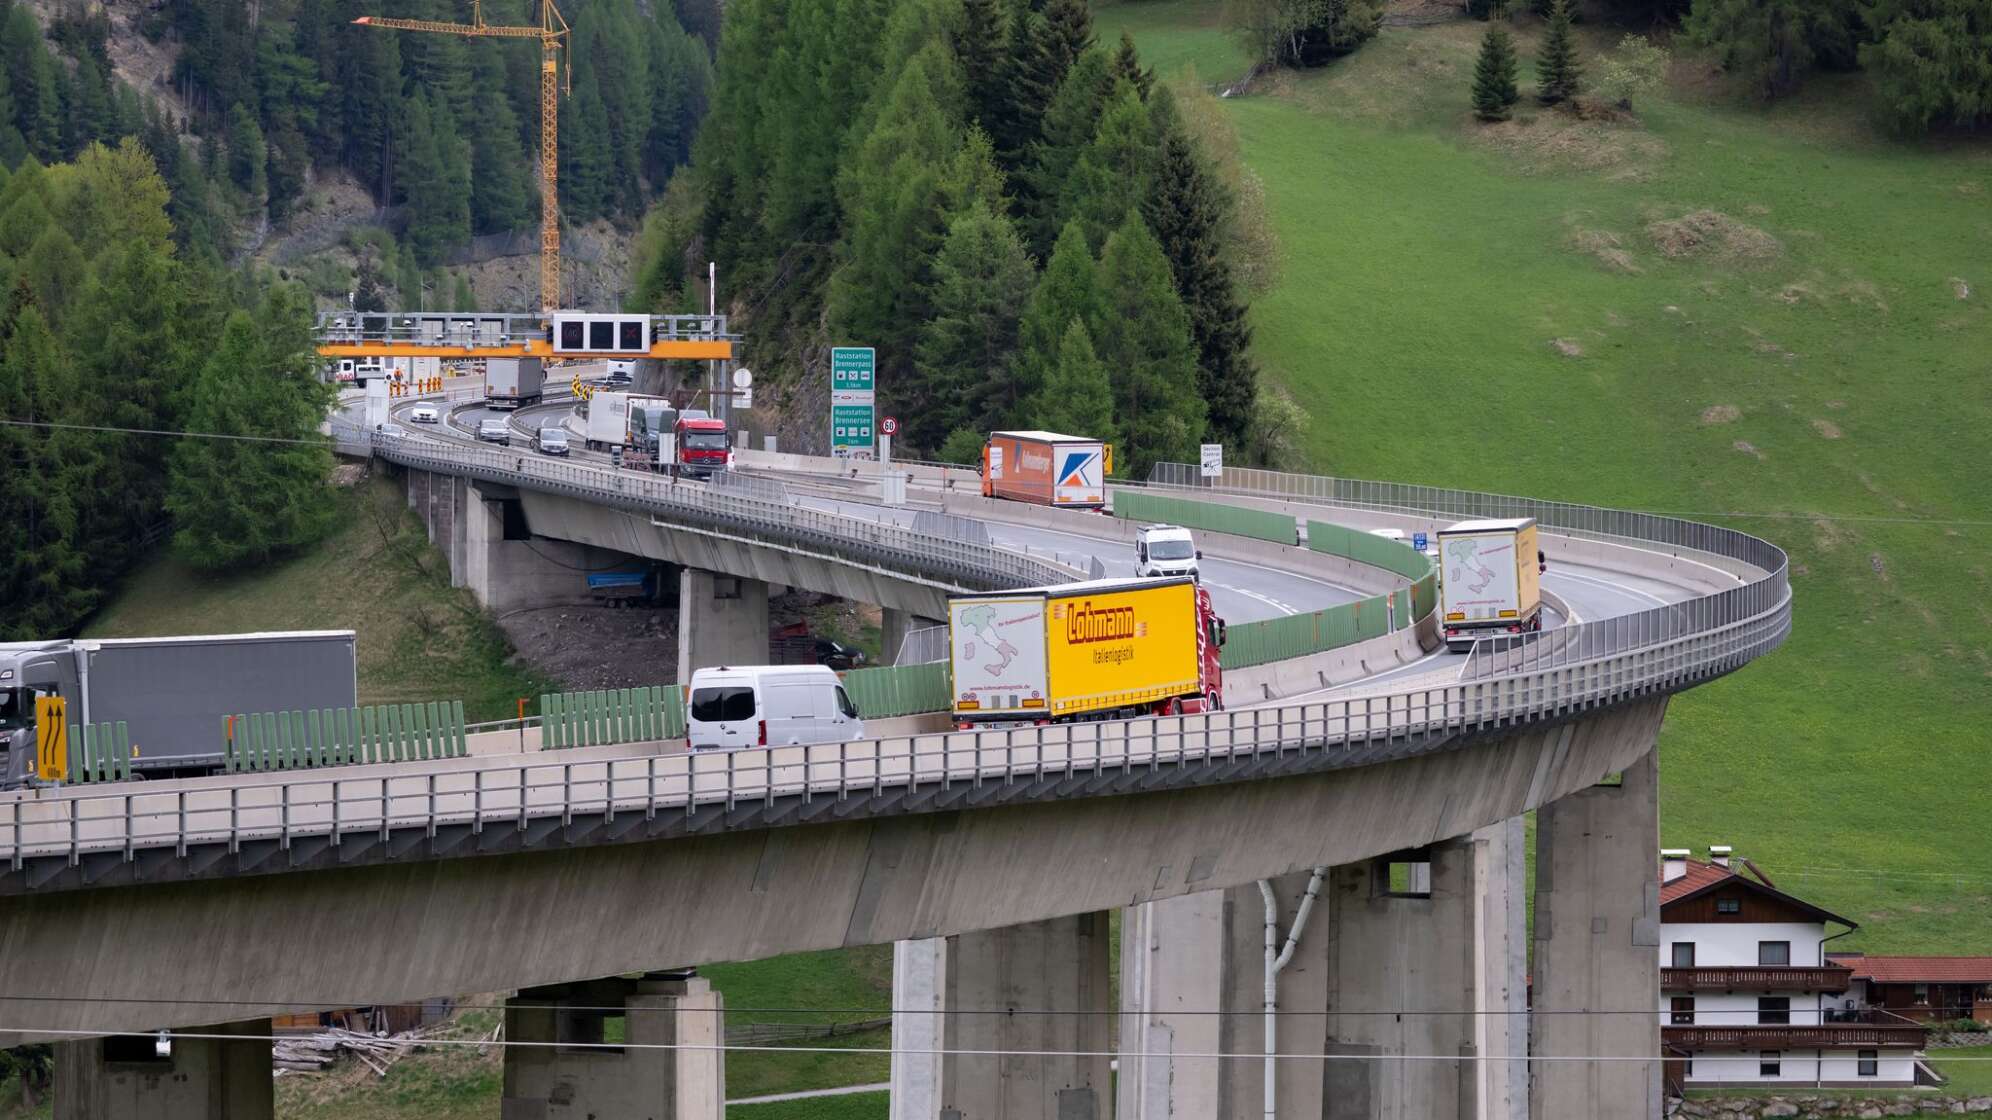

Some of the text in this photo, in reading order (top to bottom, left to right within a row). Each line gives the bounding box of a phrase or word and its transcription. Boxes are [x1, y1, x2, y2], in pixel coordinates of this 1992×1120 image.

[835, 360, 871, 368] Brennerpass
[884, 421, 894, 430] 60
[1067, 601, 1135, 645] Lohmann
[1093, 645, 1134, 665] Italienlogistik
